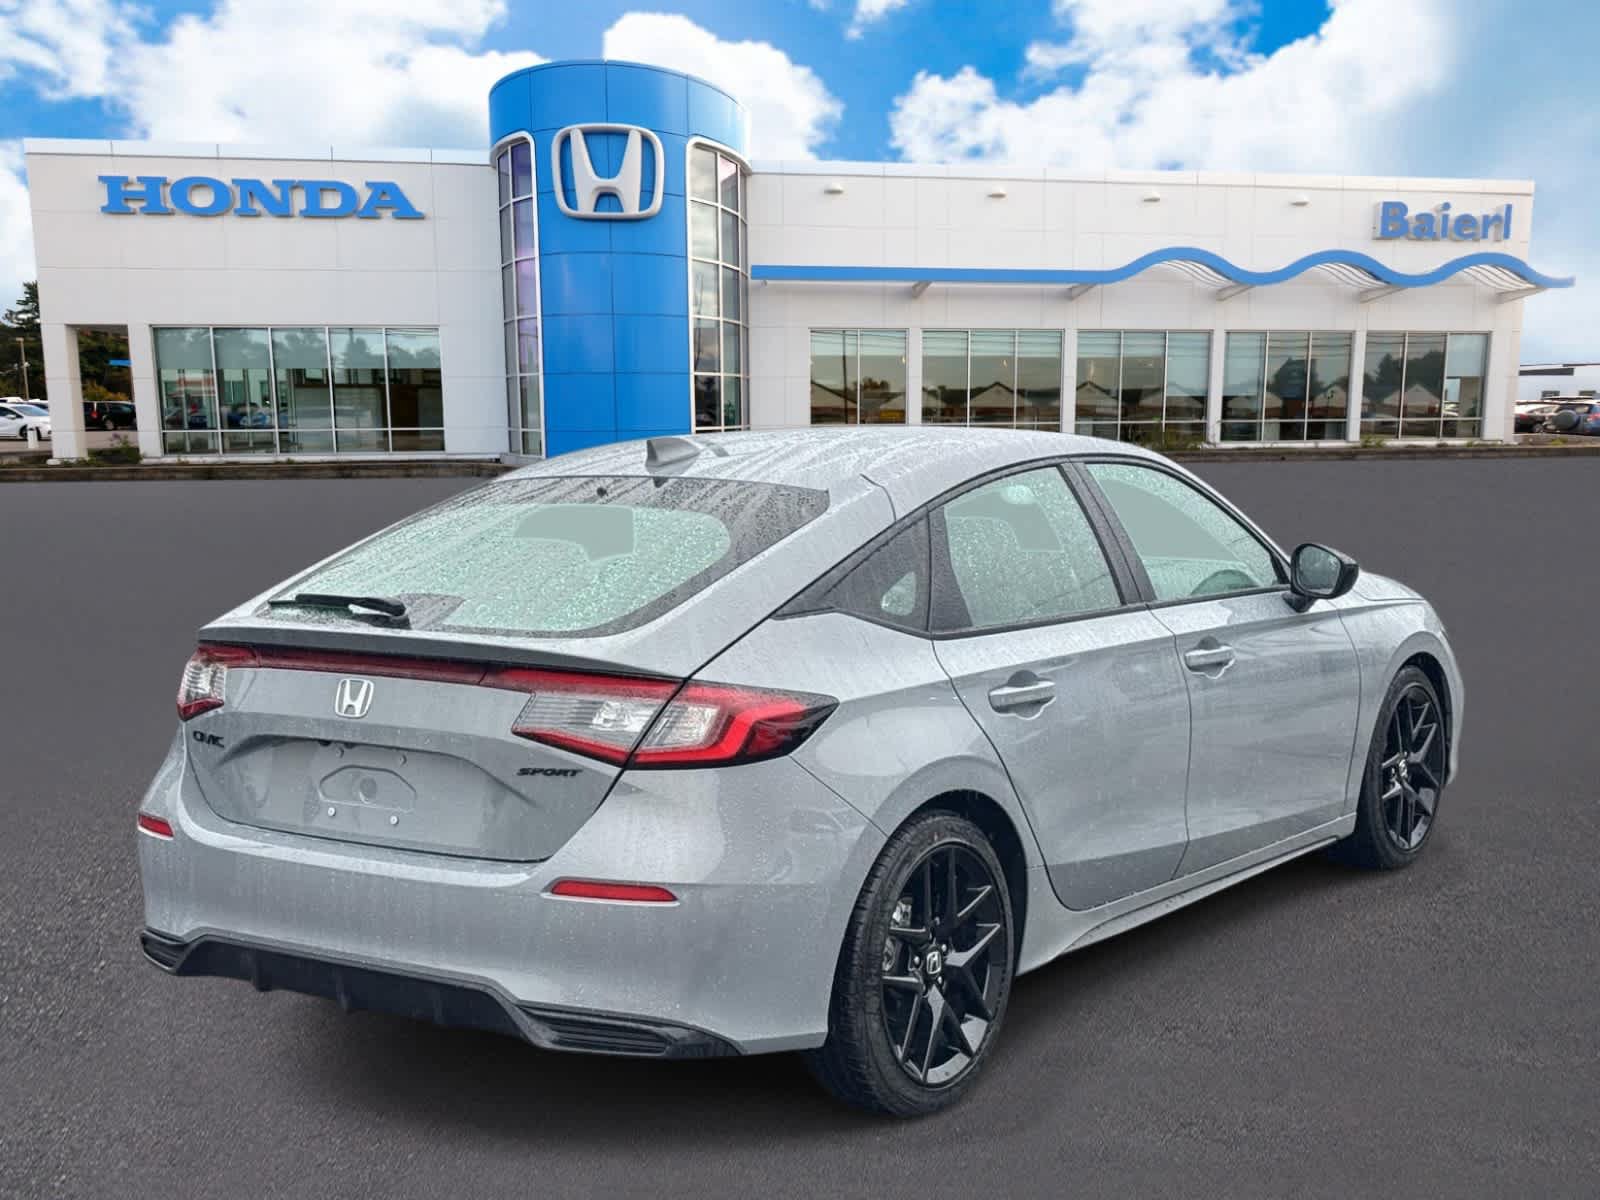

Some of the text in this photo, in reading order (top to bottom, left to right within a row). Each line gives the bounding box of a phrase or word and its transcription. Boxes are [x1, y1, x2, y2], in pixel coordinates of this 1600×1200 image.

[97, 174, 426, 220] HONDA
[1378, 200, 1513, 240] Baierl
[516, 767, 583, 776] SPORT
